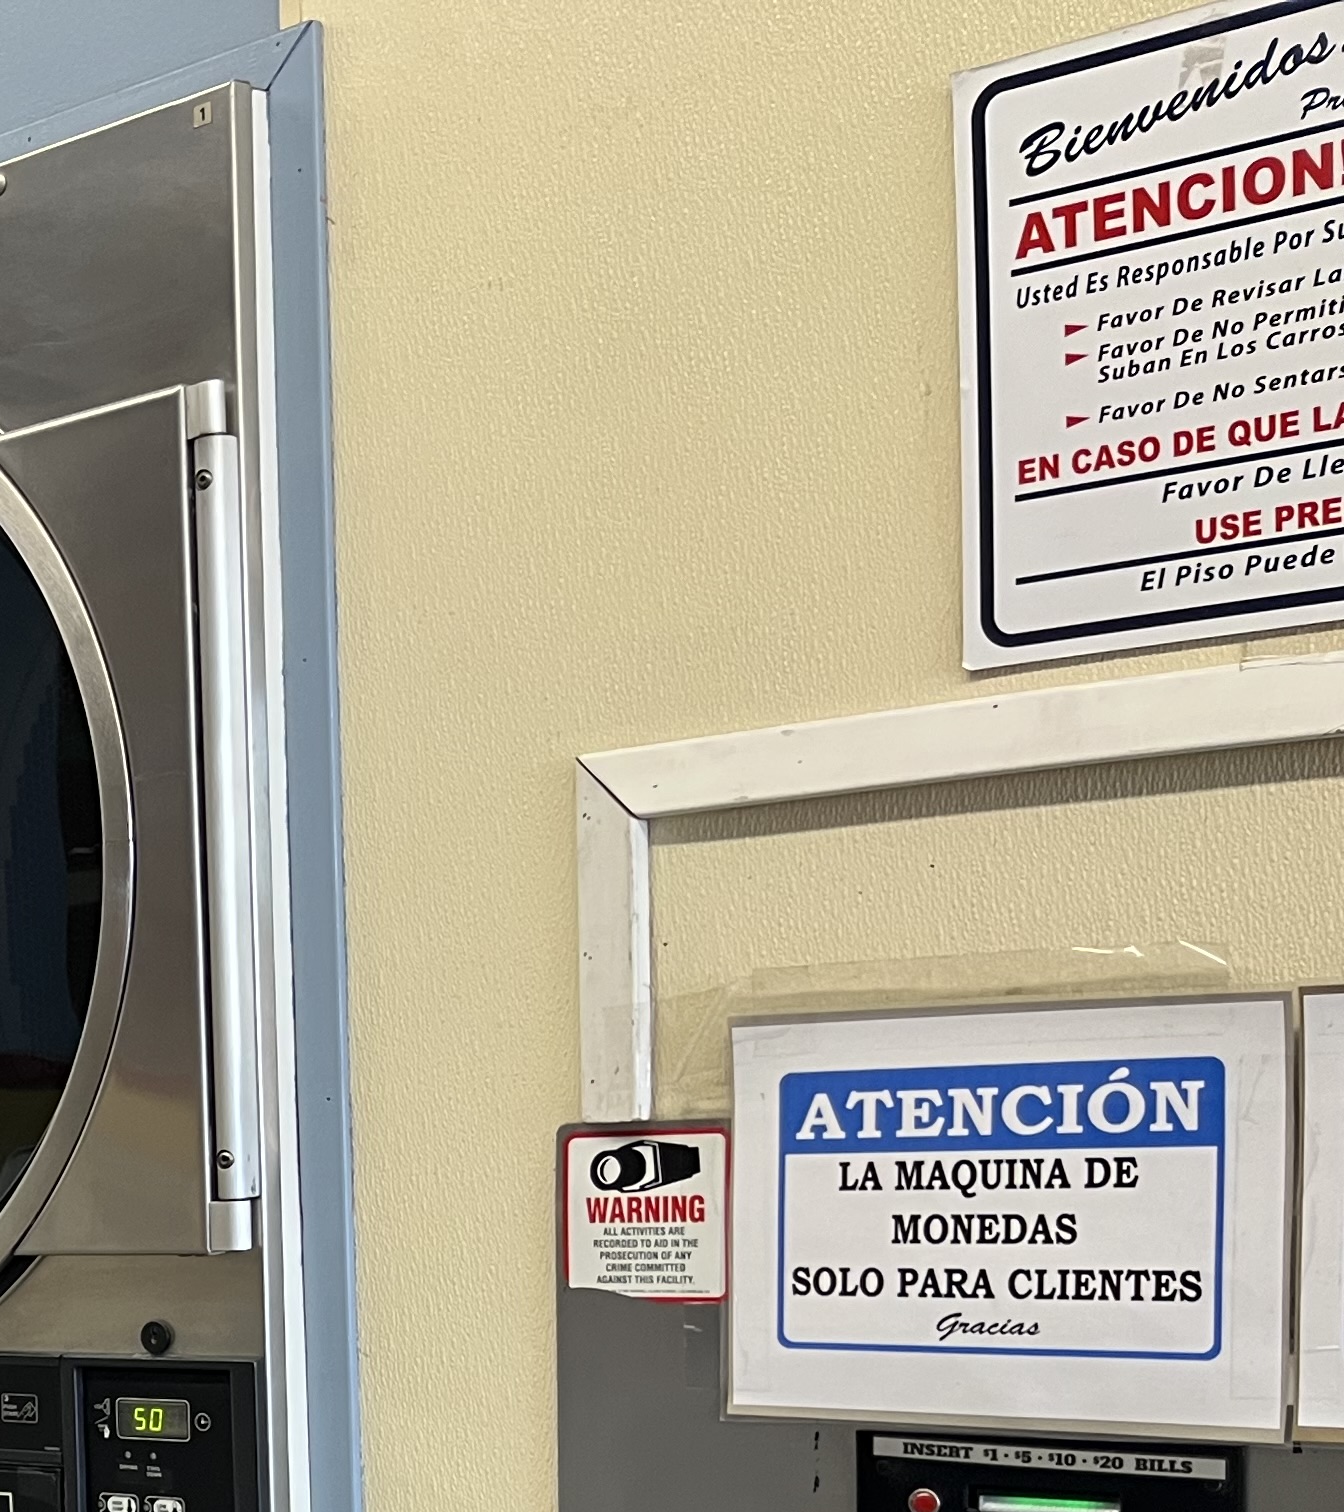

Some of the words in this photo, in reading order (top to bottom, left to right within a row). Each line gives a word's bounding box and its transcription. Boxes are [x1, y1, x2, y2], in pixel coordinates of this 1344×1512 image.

[1019, 31, 1336, 177] Bienvenidos
[1016, 276, 1078, 309] Usted
[1086, 272, 1109, 295] Es
[1117, 237, 1265, 288] Responsable
[1273, 228, 1315, 255] Por
[1097, 305, 1165, 331] Favor
[1172, 297, 1203, 316] De
[1212, 275, 1305, 307] Revisar
[1313, 268, 1342, 288] La
[1098, 336, 1165, 362] Favor
[1173, 328, 1204, 347] De
[1212, 319, 1244, 340] No
[1098, 359, 1171, 384] Suban
[1180, 349, 1208, 368] En
[1217, 340, 1257, 361] Los
[1266, 322, 1344, 350] Carros
[1098, 398, 1166, 424] Favor
[1173, 391, 1204, 410] De
[1213, 382, 1245, 403] No
[1018, 453, 1060, 485] EN
[1071, 436, 1161, 475] CASO
[1173, 425, 1216, 457] DE
[1228, 410, 1300, 447] QUE
[1162, 474, 1244, 503] Favor
[1254, 466, 1292, 488] De
[1302, 454, 1344, 480] Lle
[1195, 509, 1262, 545] USE
[1275, 497, 1342, 533] PRE
[1140, 567, 1164, 592] El
[1175, 561, 1234, 587] Piso
[1244, 545, 1336, 577] Puede
[796, 1067, 1204, 1141] ATENCIÓN
[838, 1160, 883, 1191] LA
[894, 1157, 1071, 1197] MAQUINA
[1084, 1156, 1140, 1189] DE
[586, 1194, 706, 1224] WARNING
[891, 1213, 1078, 1246] MONEDAS
[593, 1239, 639, 1248] RECORDED
[640, 1239, 652, 1248] TO
[654, 1239, 668, 1248] AID
[671, 1239, 680, 1248] IN
[682, 1238, 699, 1248] THE
[603, 1227, 618, 1236] ALL
[620, 1227, 666, 1236] ACTIVITIES
[668, 1226, 686, 1236] ARE
[599, 1251, 659, 1260] PROSECUTION
[661, 1251, 672, 1260] OF
[674, 1251, 692, 1260] ANY
[605, 1263, 633, 1272] CRIME
[634, 1263, 686, 1272] COMMITTED
[597, 1275, 633, 1284] AGAINST
[634, 1275, 654, 1284] THIS
[791, 1266, 885, 1298] SOLO
[897, 1266, 995, 1300] PARA
[1008, 1266, 1203, 1302] CLIENTES
[936, 1312, 1041, 1341] Gracias
[134, 1407, 163, 1432] 50
[902, 1442, 974, 1459] INSERT
[983, 1448, 999, 1462] $1
[1014, 1450, 1032, 1464] $5
[1048, 1452, 1077, 1467] $10
[1093, 1455, 1124, 1470] $20
[1135, 1457, 1193, 1474] BILLS
